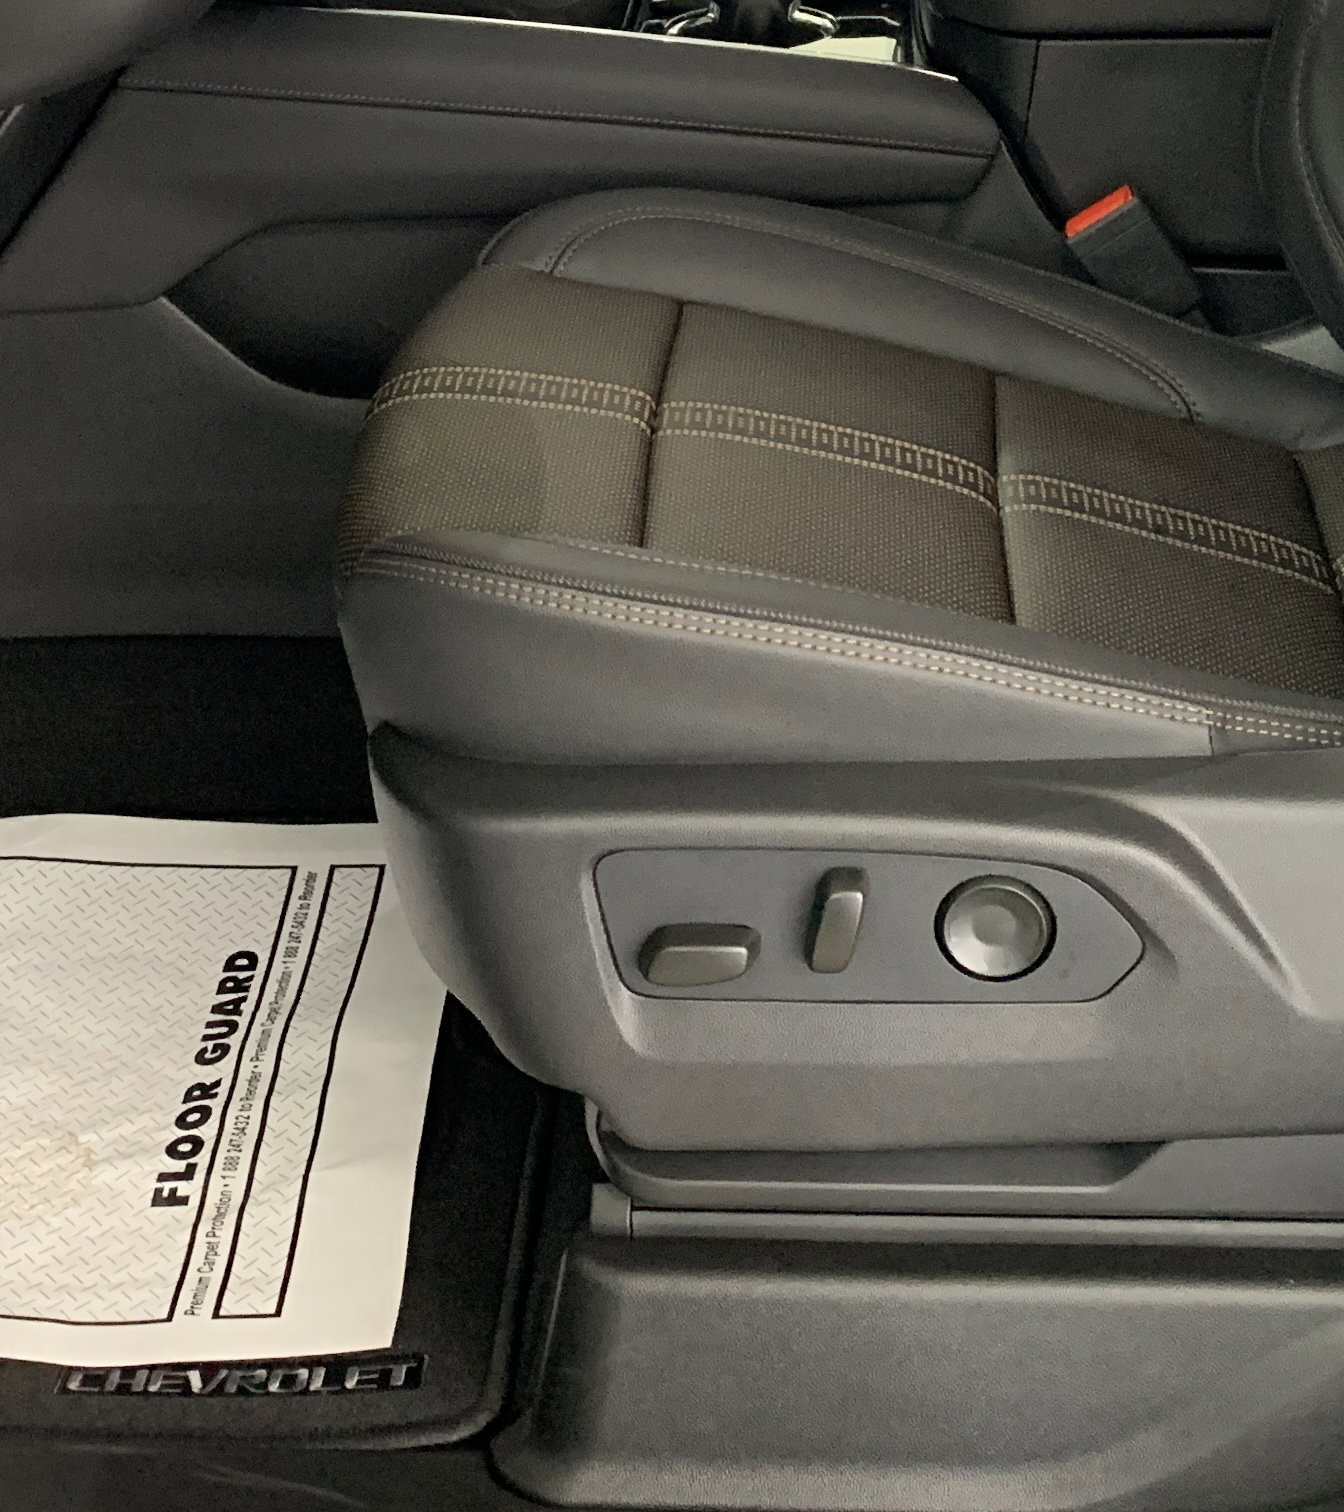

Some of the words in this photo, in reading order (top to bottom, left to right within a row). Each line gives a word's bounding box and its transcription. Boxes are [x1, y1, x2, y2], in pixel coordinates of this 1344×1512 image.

[150, 1078, 222, 1208] FLOOR
[194, 950, 259, 1066] GUARD
[239, 1102, 253, 1113] to
[206, 1187, 232, 1239] Protection
[197, 1237, 221, 1274] Carpet
[184, 1275, 210, 1317] Premium
[67, 1362, 419, 1395] CHEVROLET
